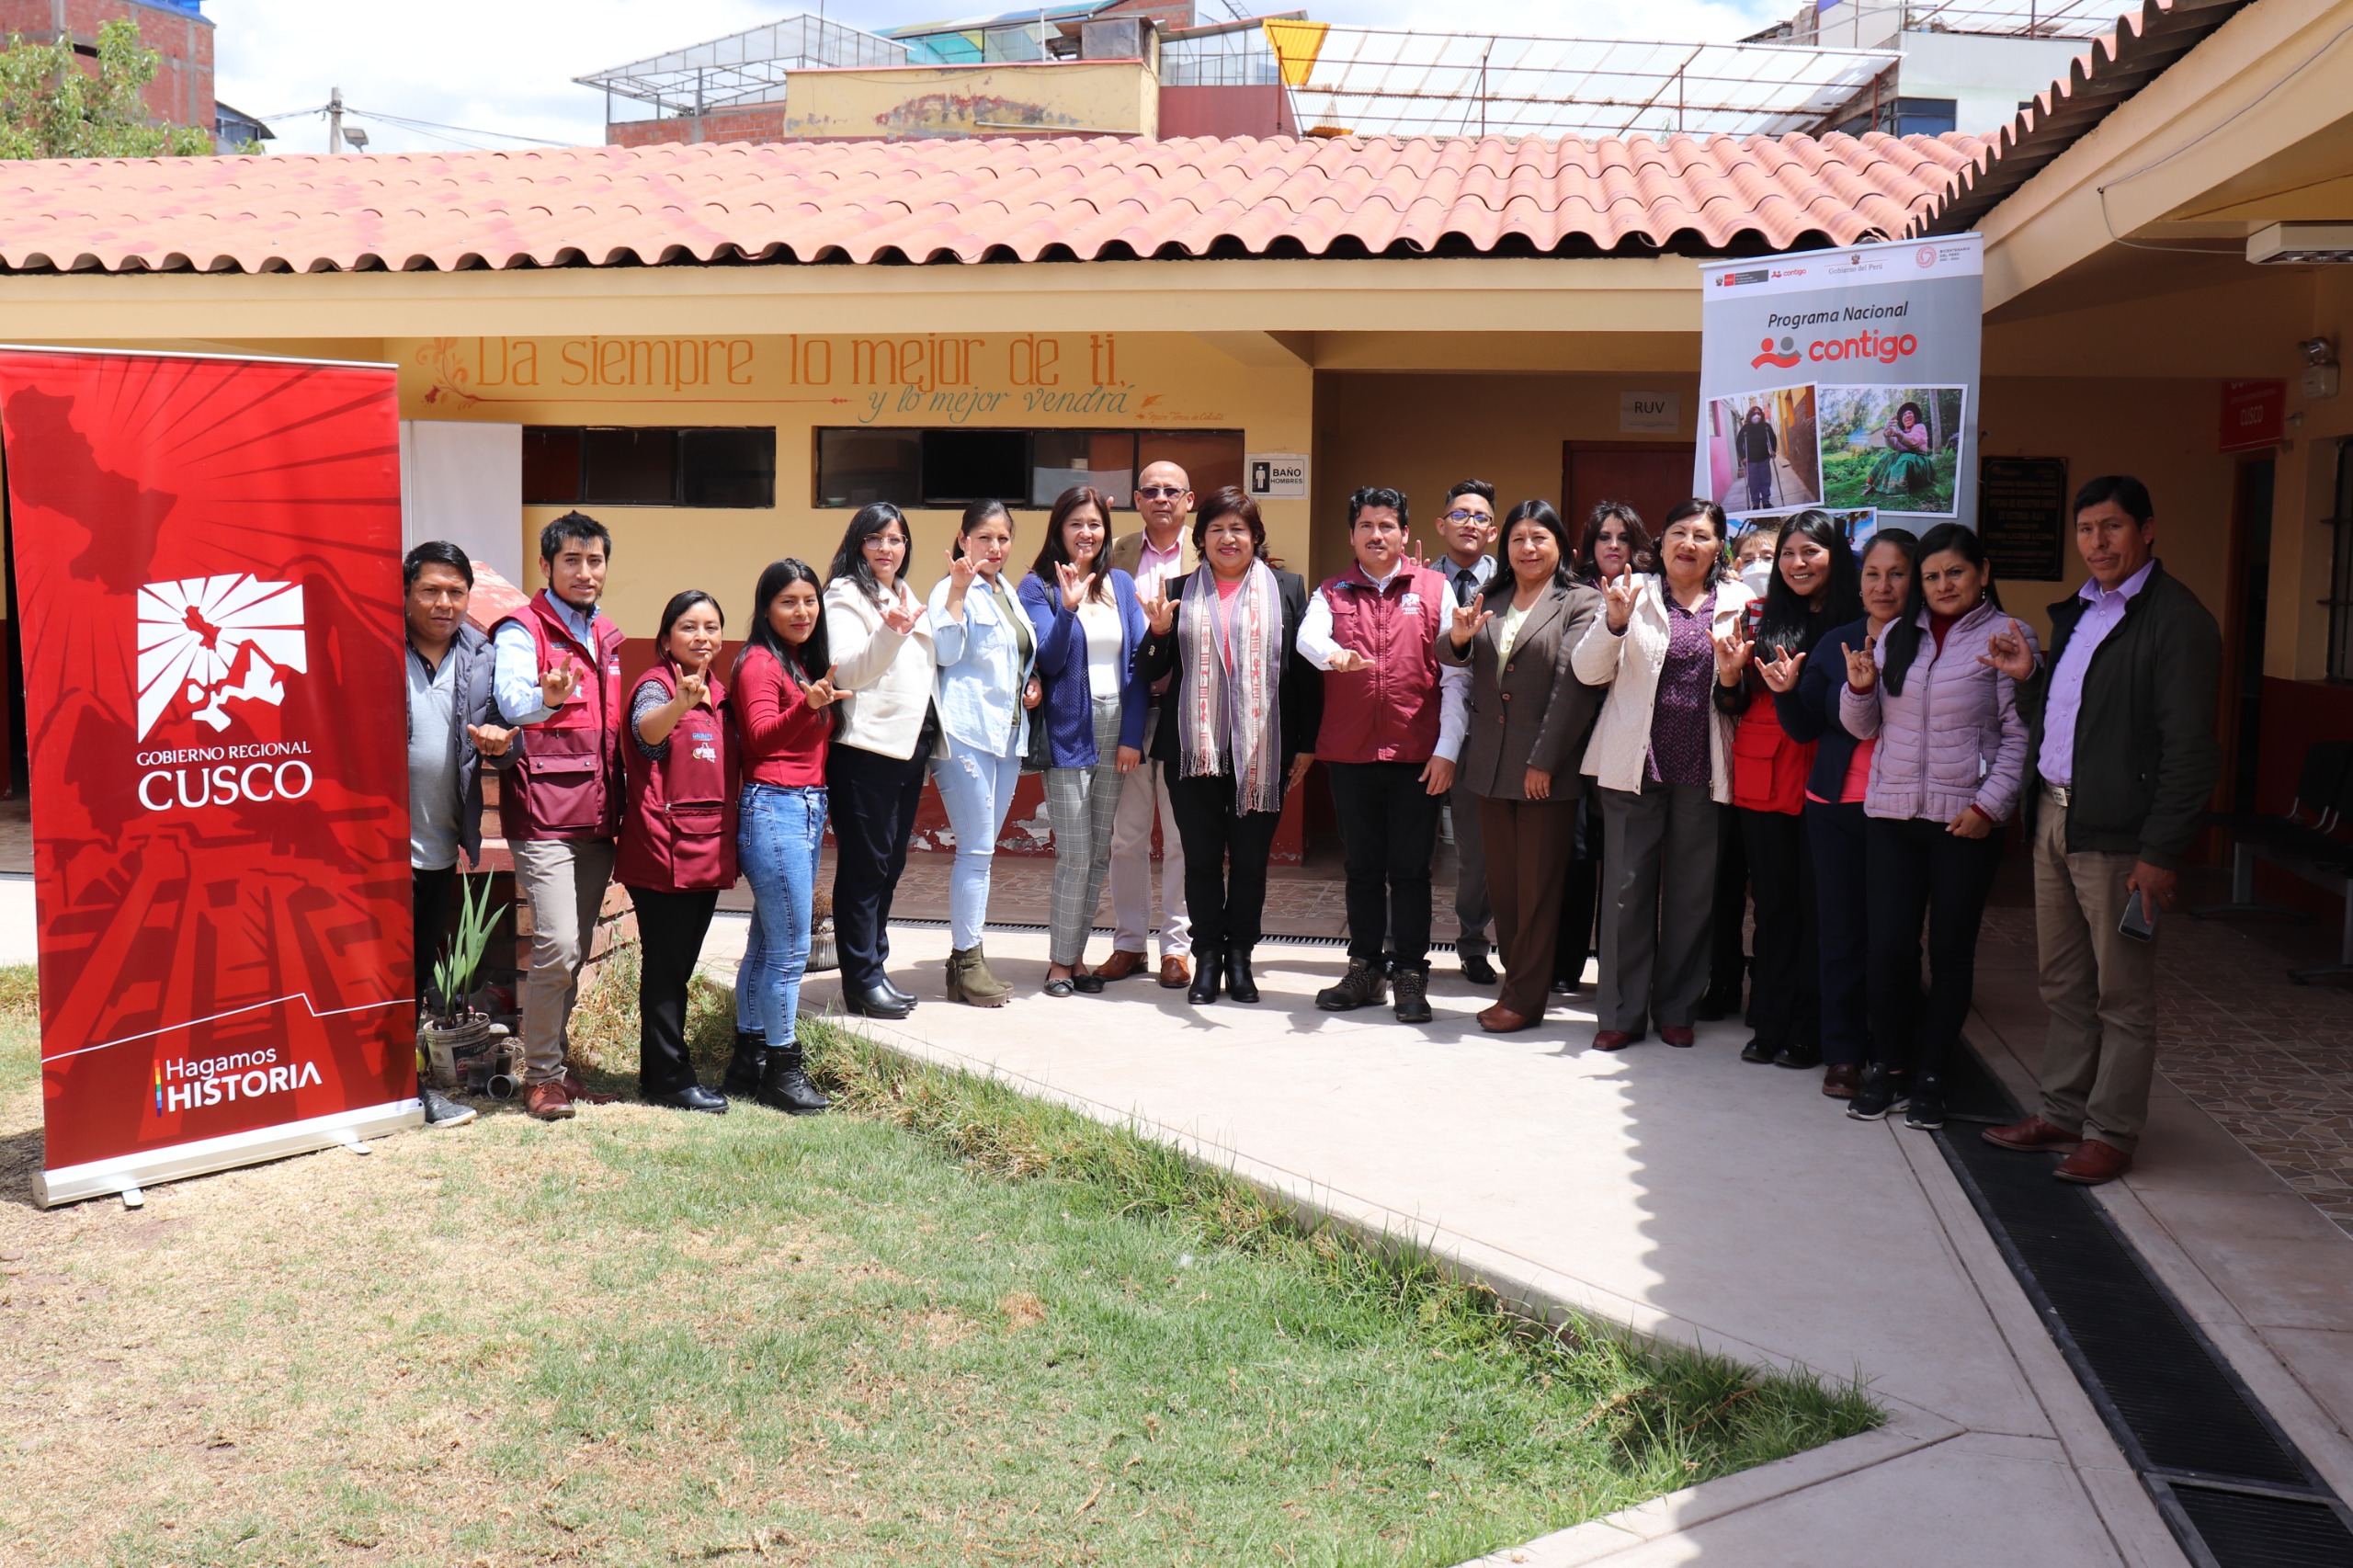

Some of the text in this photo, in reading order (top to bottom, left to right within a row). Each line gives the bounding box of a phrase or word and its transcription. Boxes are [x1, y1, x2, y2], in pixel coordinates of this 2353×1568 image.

[1768, 301, 1908, 329] Programa Nacional
[476, 333, 1126, 392] Da siempre lo mejor de ti,
[1809, 329, 1917, 364] contigo
[858, 384, 1136, 423] y lo mejor vendrá
[1635, 402, 1665, 414] RUV
[2240, 405, 2264, 426] CUSCO
[1273, 467, 1301, 477] BAÑO
[136, 741, 312, 766] GOBIERNO REGIONAL
[138, 760, 313, 811] CUSCO
[165, 1048, 278, 1080] Hagamos
[167, 1061, 323, 1112] HISTORIA
